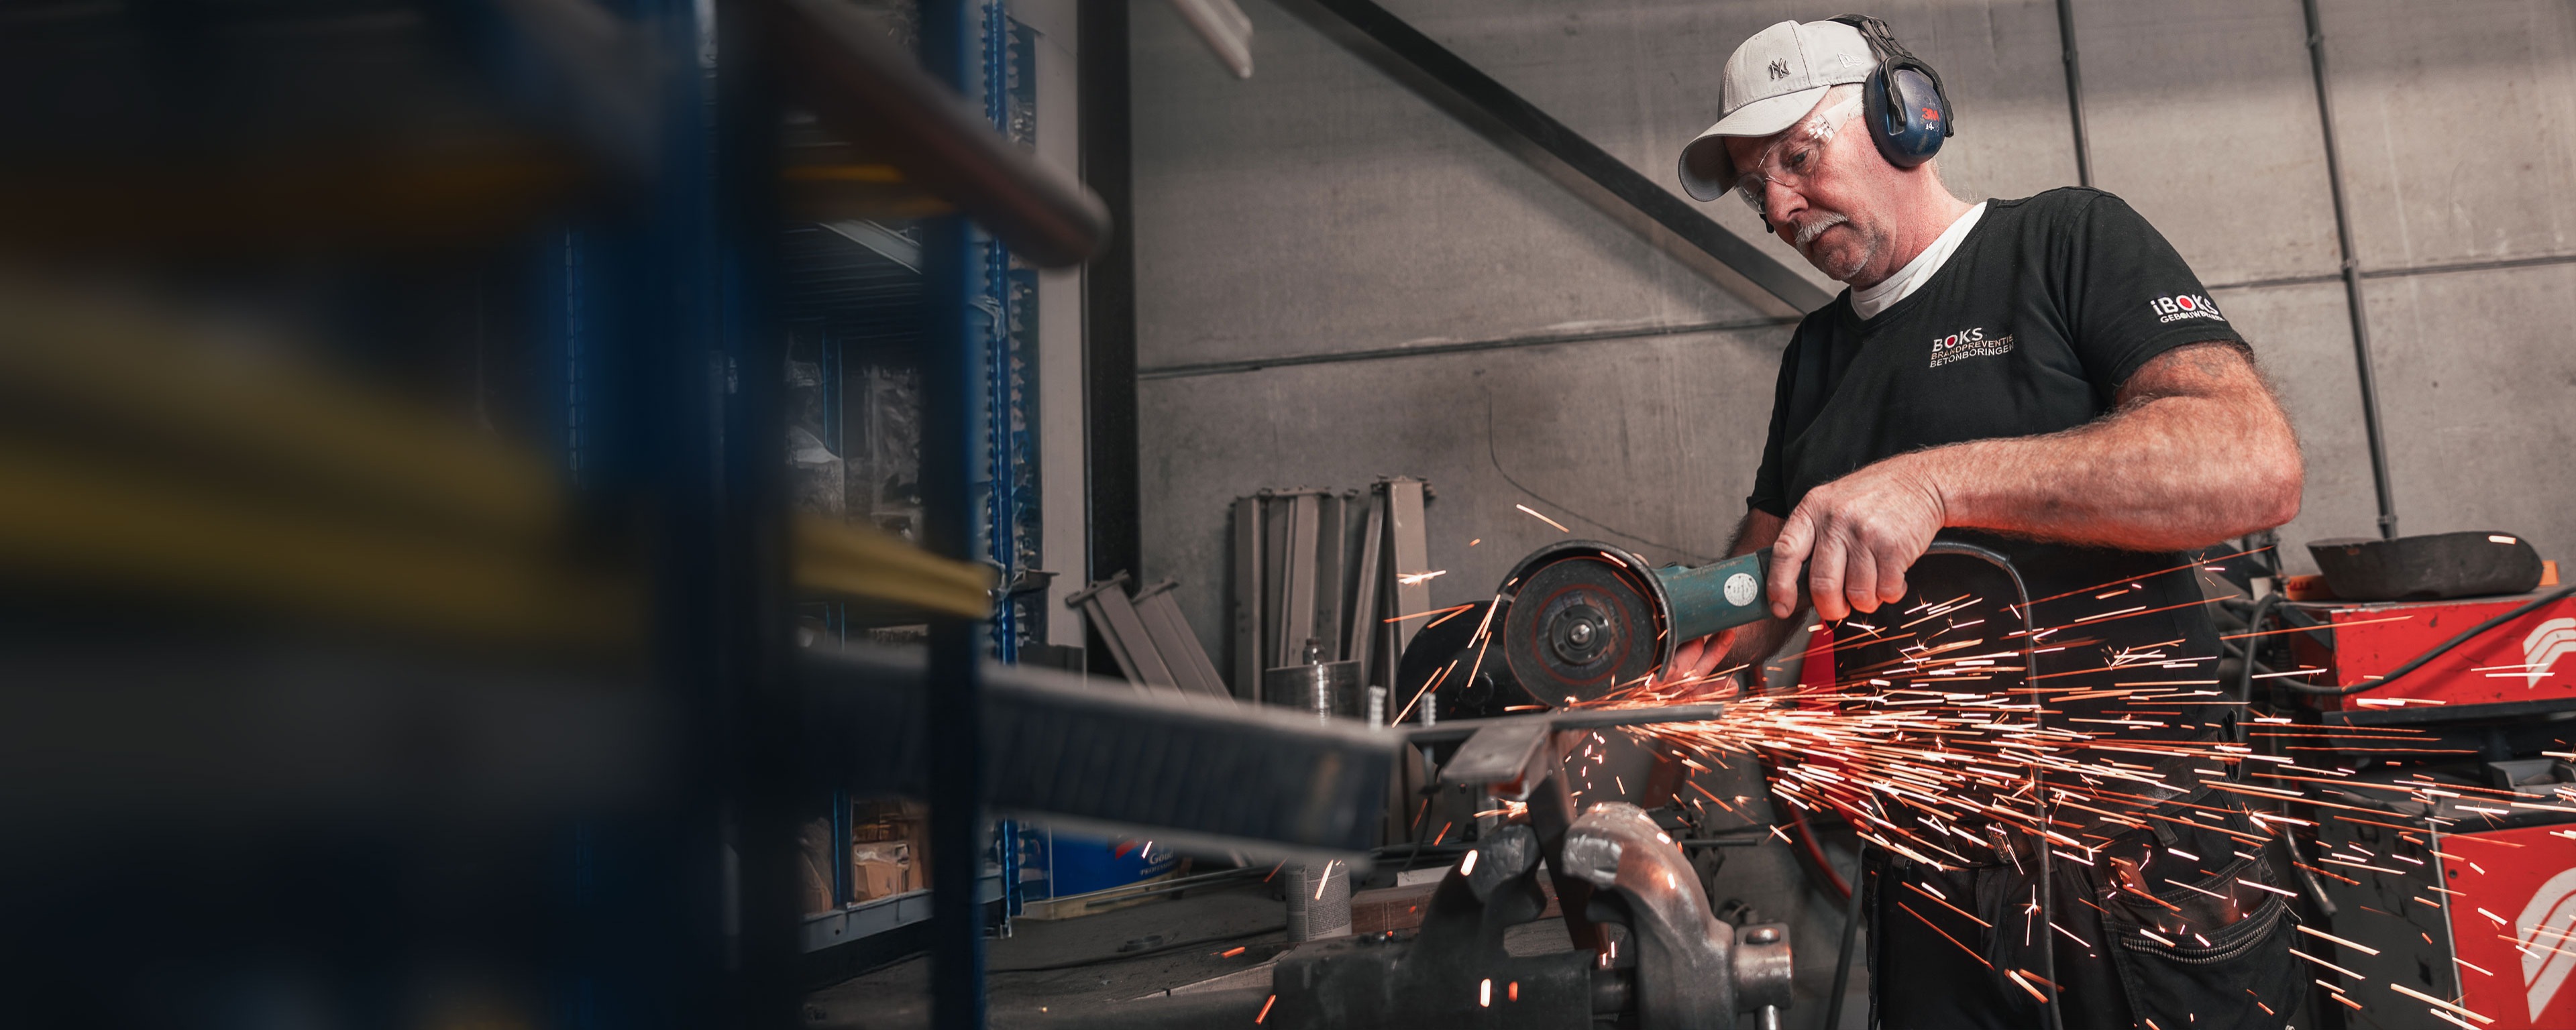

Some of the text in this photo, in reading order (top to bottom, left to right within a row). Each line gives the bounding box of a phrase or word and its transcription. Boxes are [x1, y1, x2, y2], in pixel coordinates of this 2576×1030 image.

[1921, 107, 1939, 122] 3M
[1931, 333, 2013, 360] BRANDPREVENTIE
[1932, 327, 1983, 352] BOKS
[1929, 341, 2014, 368] BETONBORINGEN
